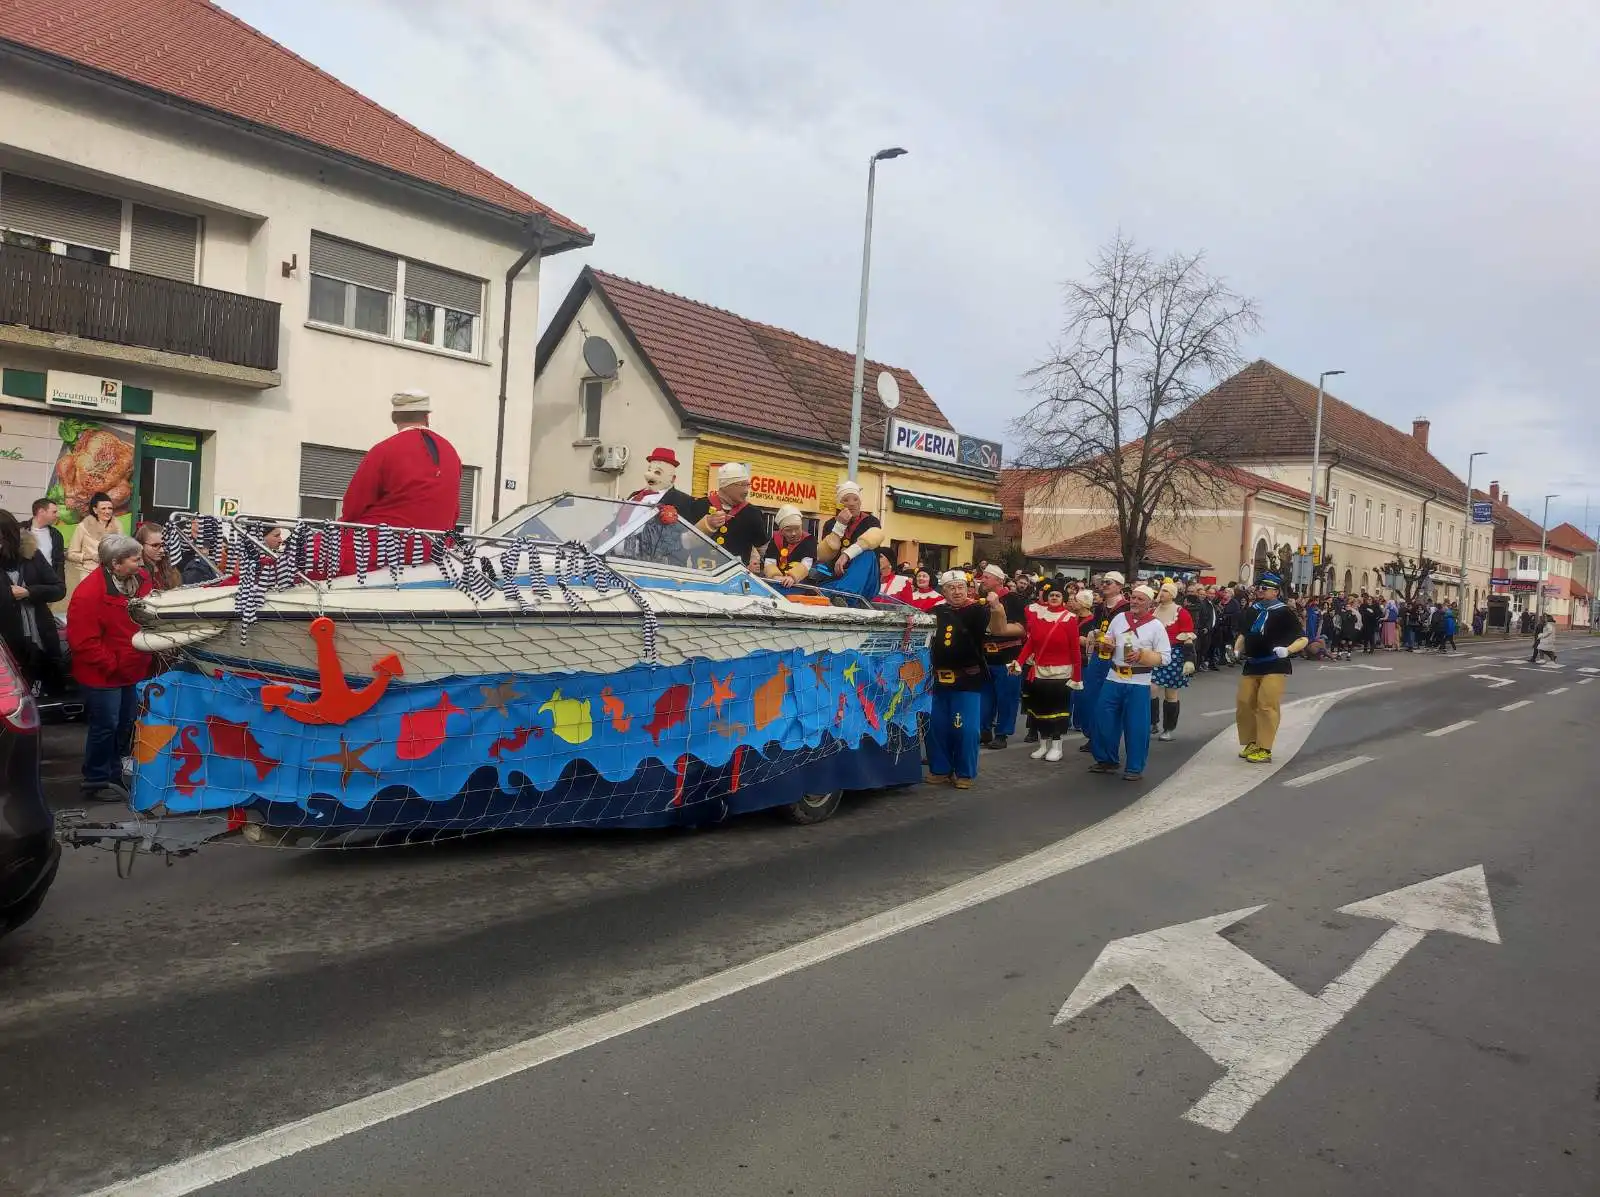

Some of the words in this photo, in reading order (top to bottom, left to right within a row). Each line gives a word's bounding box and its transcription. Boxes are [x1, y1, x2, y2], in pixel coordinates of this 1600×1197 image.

[896, 426, 956, 458] PIZZERIA
[749, 492, 774, 501] SPORTSKA
[750, 475, 817, 500] GERMANIA
